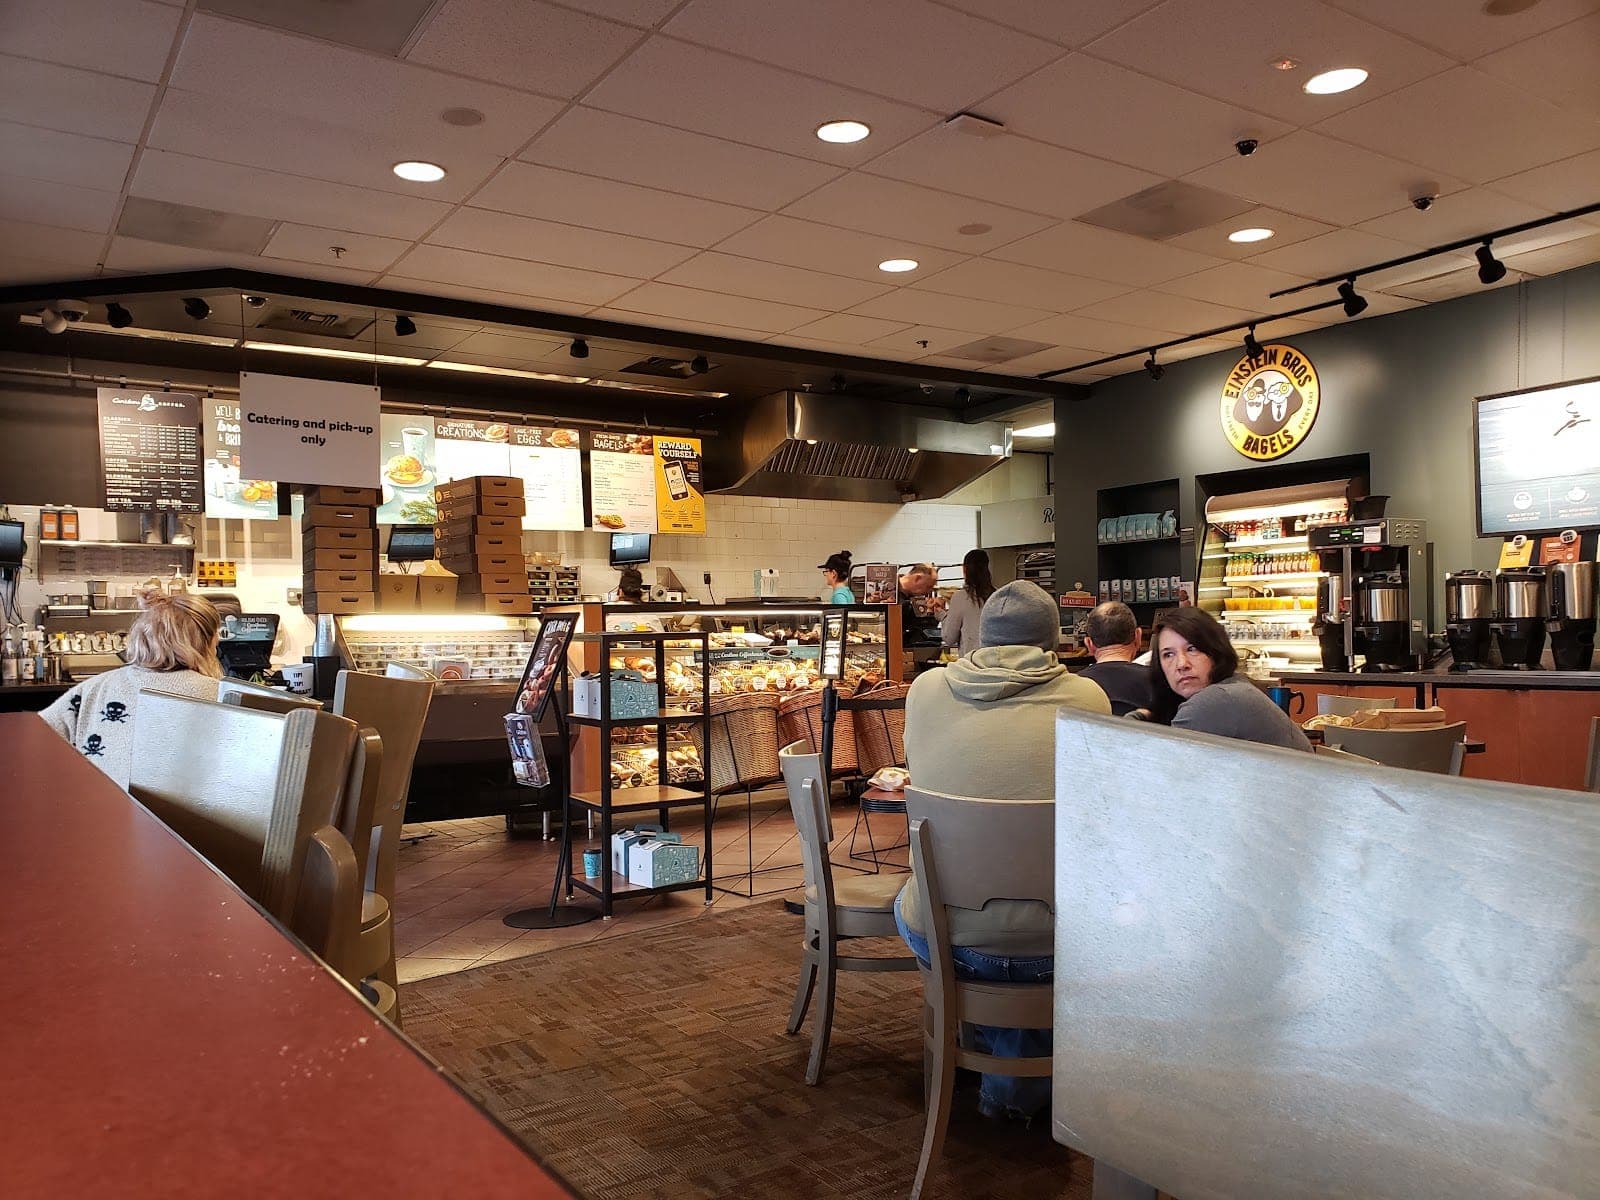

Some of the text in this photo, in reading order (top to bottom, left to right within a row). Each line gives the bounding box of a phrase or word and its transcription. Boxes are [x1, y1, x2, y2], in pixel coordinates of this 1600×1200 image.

[1225, 349, 1312, 399] EINSTEIN BROS
[247, 412, 374, 435] Catering and pick-up
[437, 425, 485, 439] CREATIONS
[301, 434, 327, 446] only
[517, 434, 542, 446] EGGS
[592, 438, 625, 451] BAGELS
[658, 441, 692, 451] REWARD
[1243, 429, 1294, 455] BAGELS
[658, 449, 698, 459] YOURSELF
